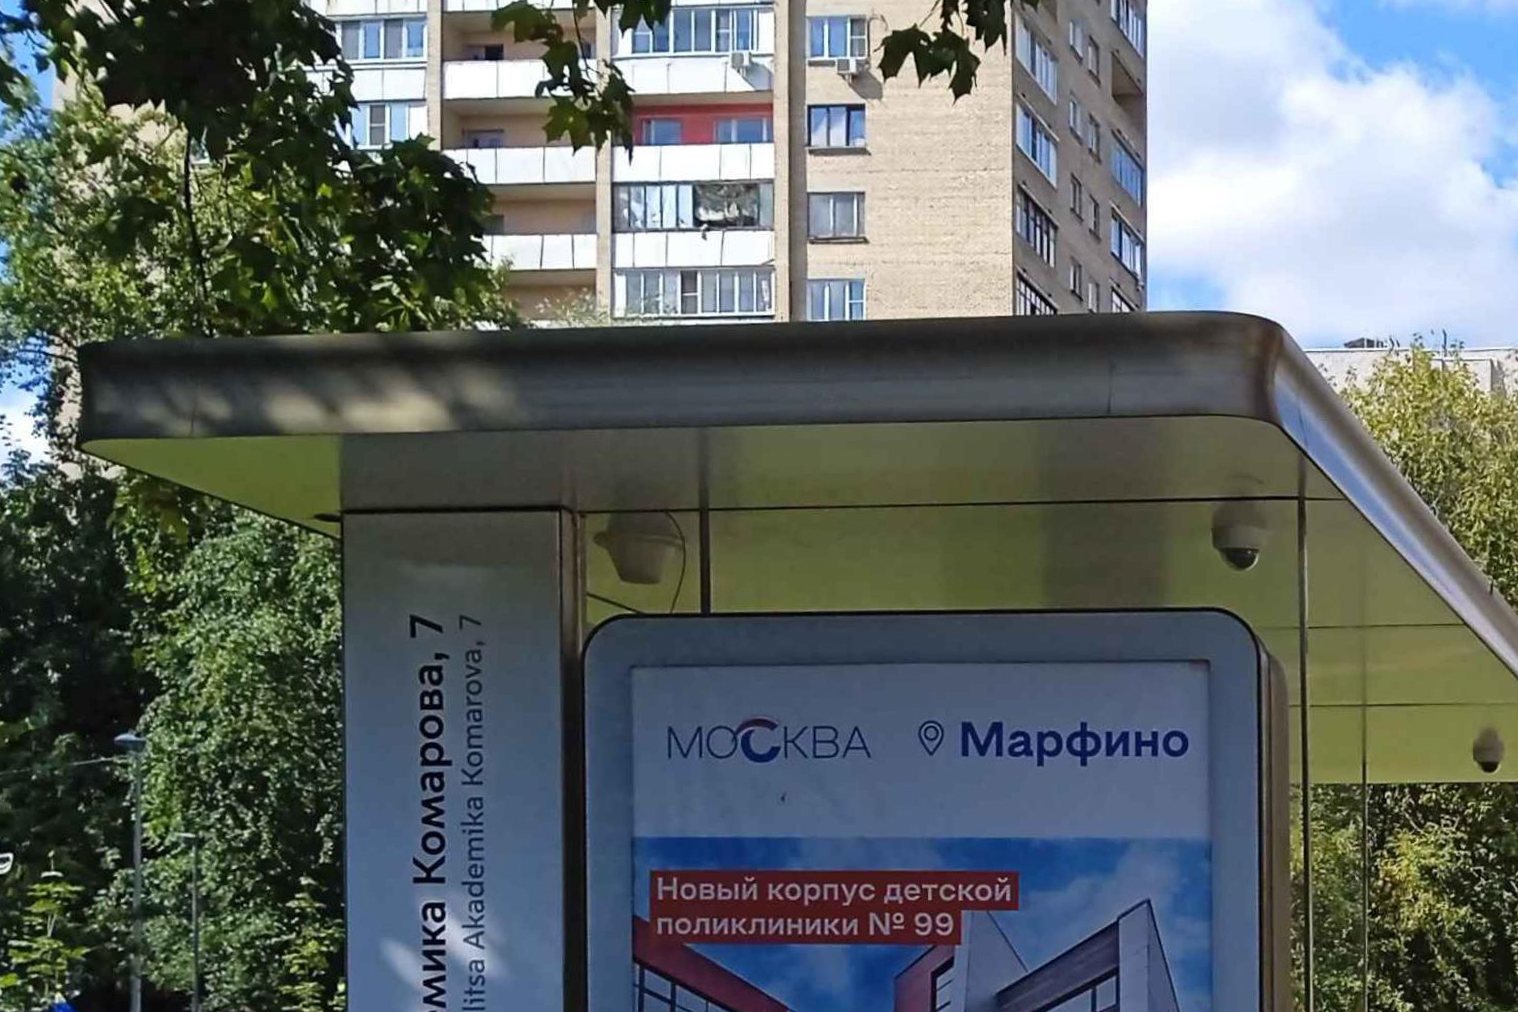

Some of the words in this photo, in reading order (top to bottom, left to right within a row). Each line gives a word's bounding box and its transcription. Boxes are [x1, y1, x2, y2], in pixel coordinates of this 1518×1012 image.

[410, 614, 444, 639] 7
[459, 614, 482, 630] 7
[461, 640, 486, 786] Komarova,
[667, 716, 872, 764] МОСКВА
[961, 721, 1189, 767] Марфино
[413, 652, 452, 884] Комарова,
[461, 797, 485, 949] Akademika
[658, 877, 758, 901] Новый
[769, 884, 876, 907] корпус
[884, 877, 1012, 905] детской
[657, 917, 859, 936] поликлиники
[869, 912, 905, 936] №
[914, 912, 954, 936] 99
